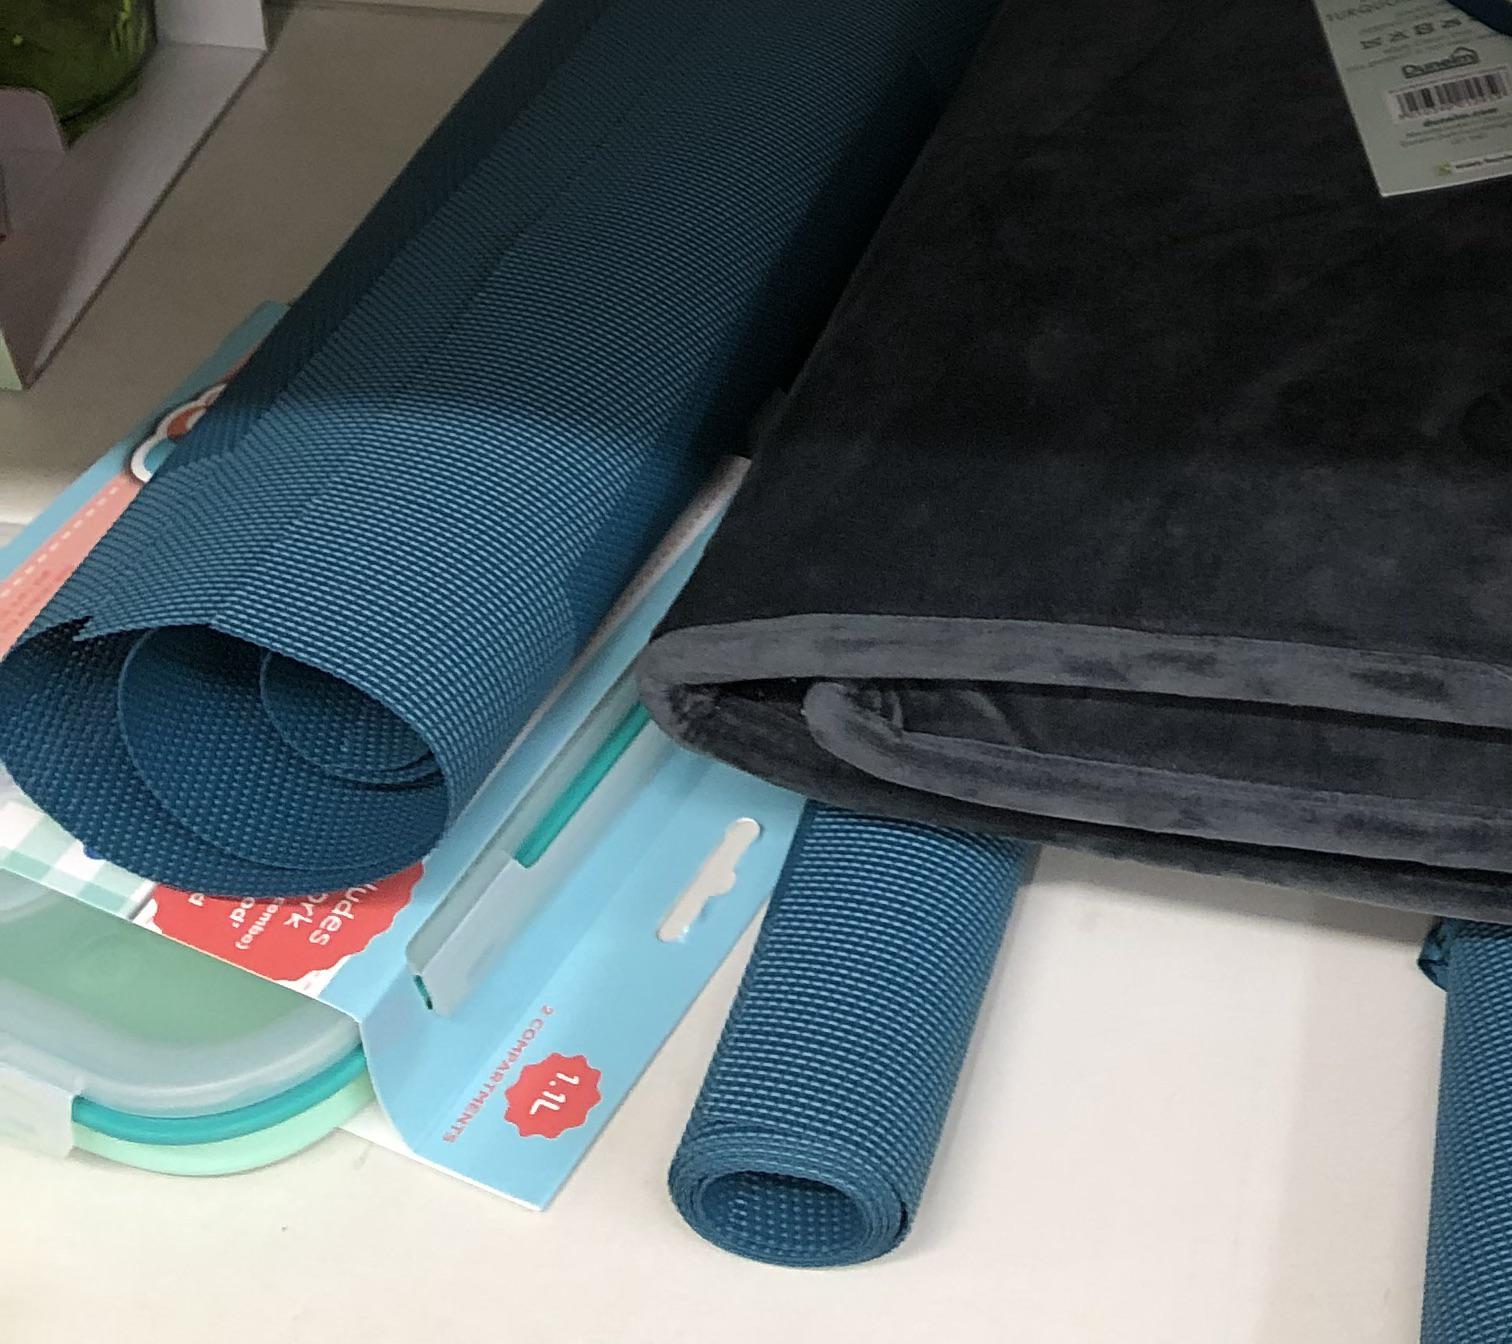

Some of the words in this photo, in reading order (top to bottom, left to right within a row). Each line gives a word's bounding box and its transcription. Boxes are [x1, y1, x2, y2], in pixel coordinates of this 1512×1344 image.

[541, 1004, 554, 1016] 2
[442, 1018, 544, 1144] COMPARTMENTS
[529, 1072, 580, 1115] 1.1L
